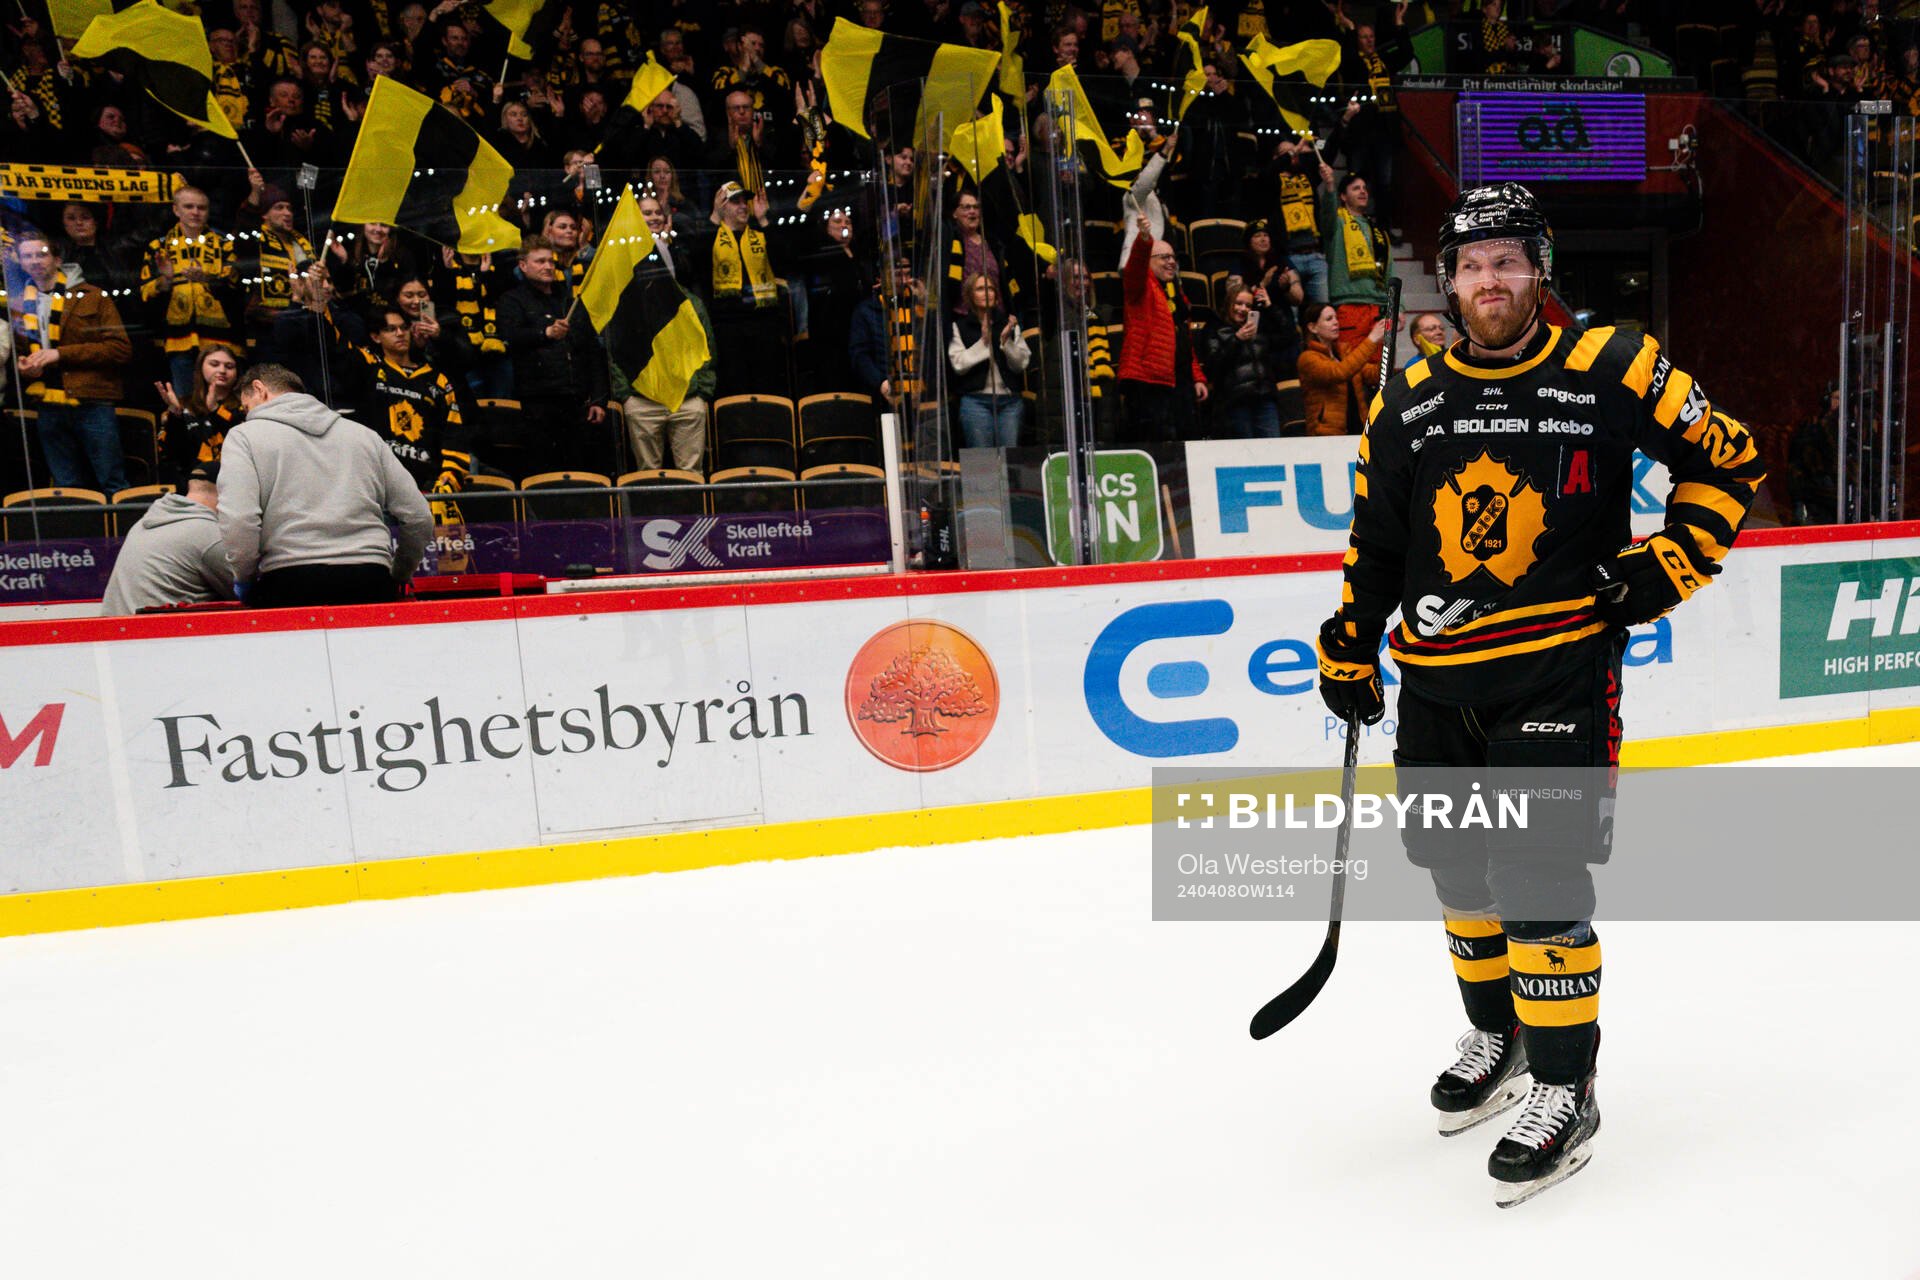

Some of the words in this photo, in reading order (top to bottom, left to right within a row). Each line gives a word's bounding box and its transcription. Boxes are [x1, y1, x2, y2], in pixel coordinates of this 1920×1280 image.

[16, 173, 39, 187] ÄR
[42, 178, 115, 191] BYGDENS
[119, 181, 149, 192] LAG
[1482, 387, 1503, 396] SHL
[1537, 387, 1596, 405] engcon
[1475, 403, 1508, 411] CCM
[1457, 418, 1529, 434] BOLIDEN
[1538, 418, 1594, 436] skebo
[1563, 450, 1592, 495] A
[726, 520, 813, 540] Skellefteå
[940, 525, 950, 553] SHL
[641, 517, 725, 570] SK
[727, 542, 772, 558] Kraft
[1484, 539, 1502, 548] 1921
[1824, 655, 1869, 676] HIGH
[153, 680, 816, 792] Fastighetsbyrån
[1521, 721, 1576, 734] CCM
[1517, 974, 1599, 997] NORRAN
